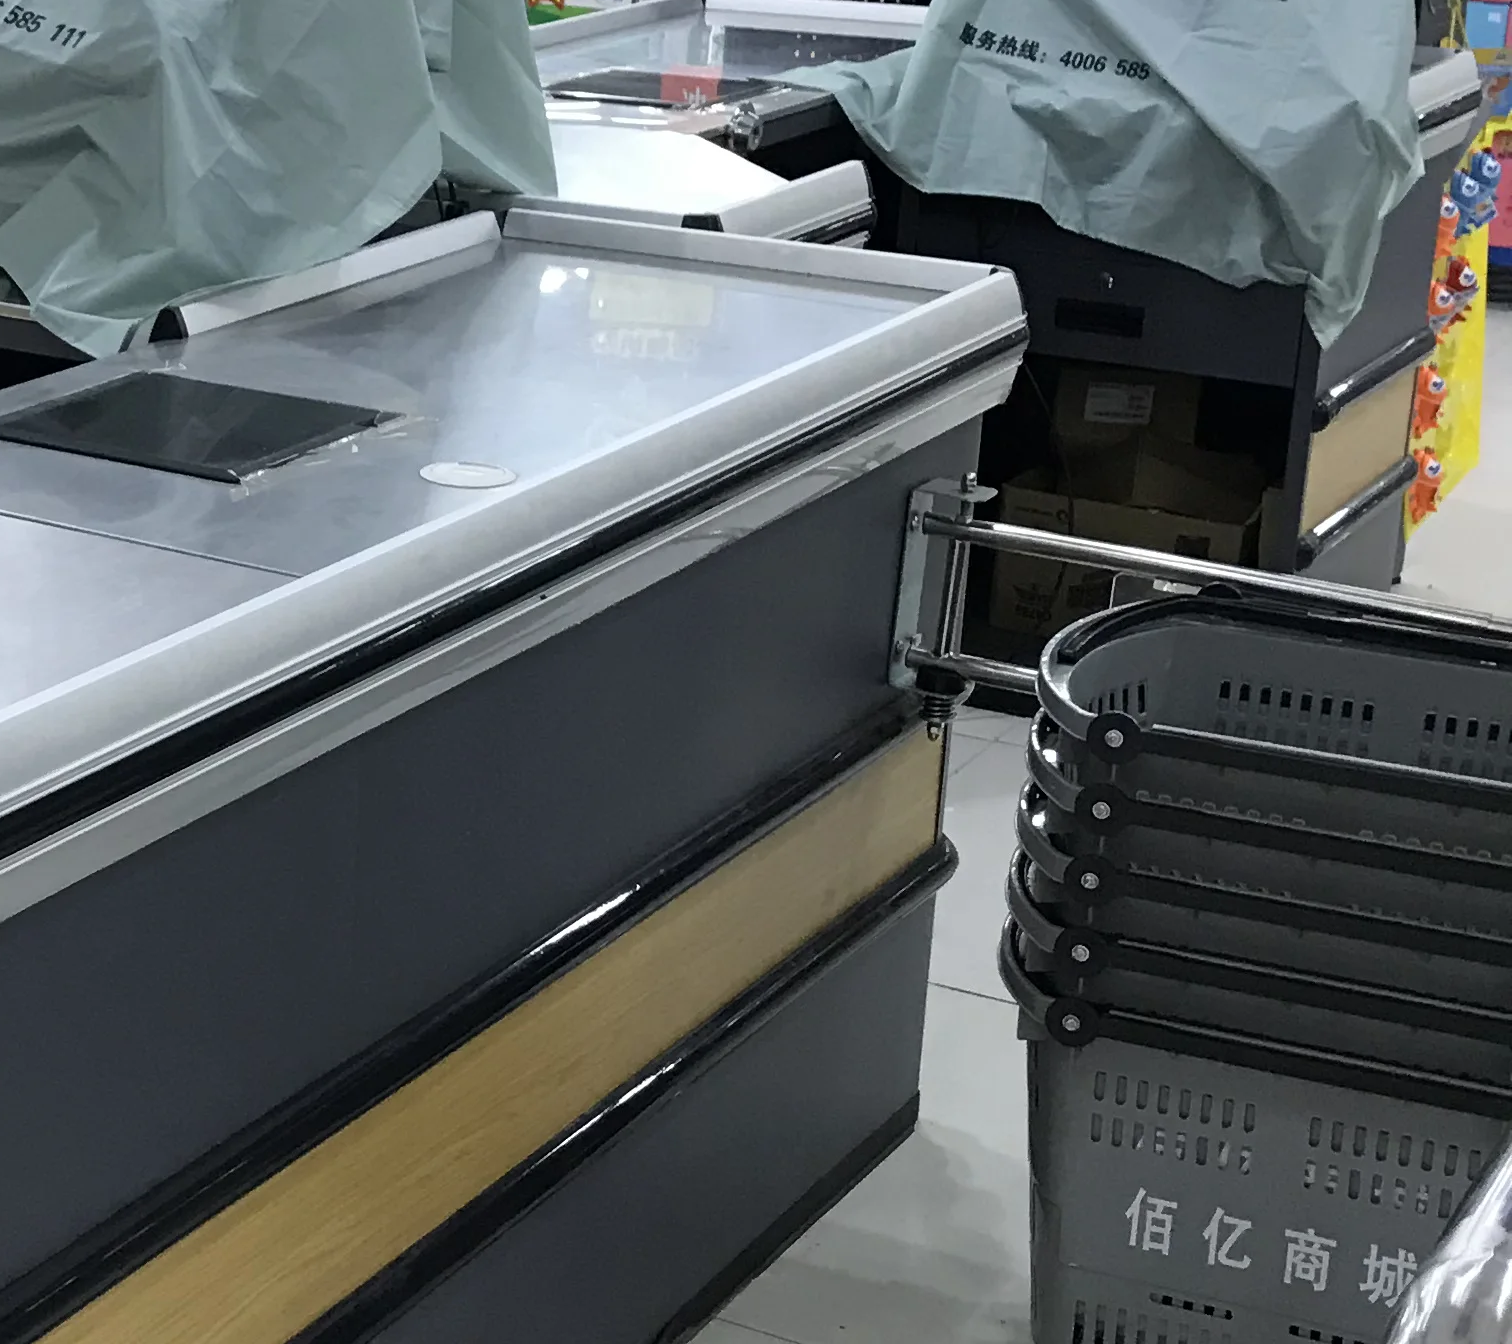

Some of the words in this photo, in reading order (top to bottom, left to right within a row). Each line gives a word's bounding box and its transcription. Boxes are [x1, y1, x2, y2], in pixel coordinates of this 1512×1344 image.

[4, 5, 47, 33] 585
[50, 23, 87, 49] 111
[1059, 50, 1108, 73] 4006
[1114, 59, 1151, 81] 585
[1125, 1186, 1418, 1308] 佰亿商城
